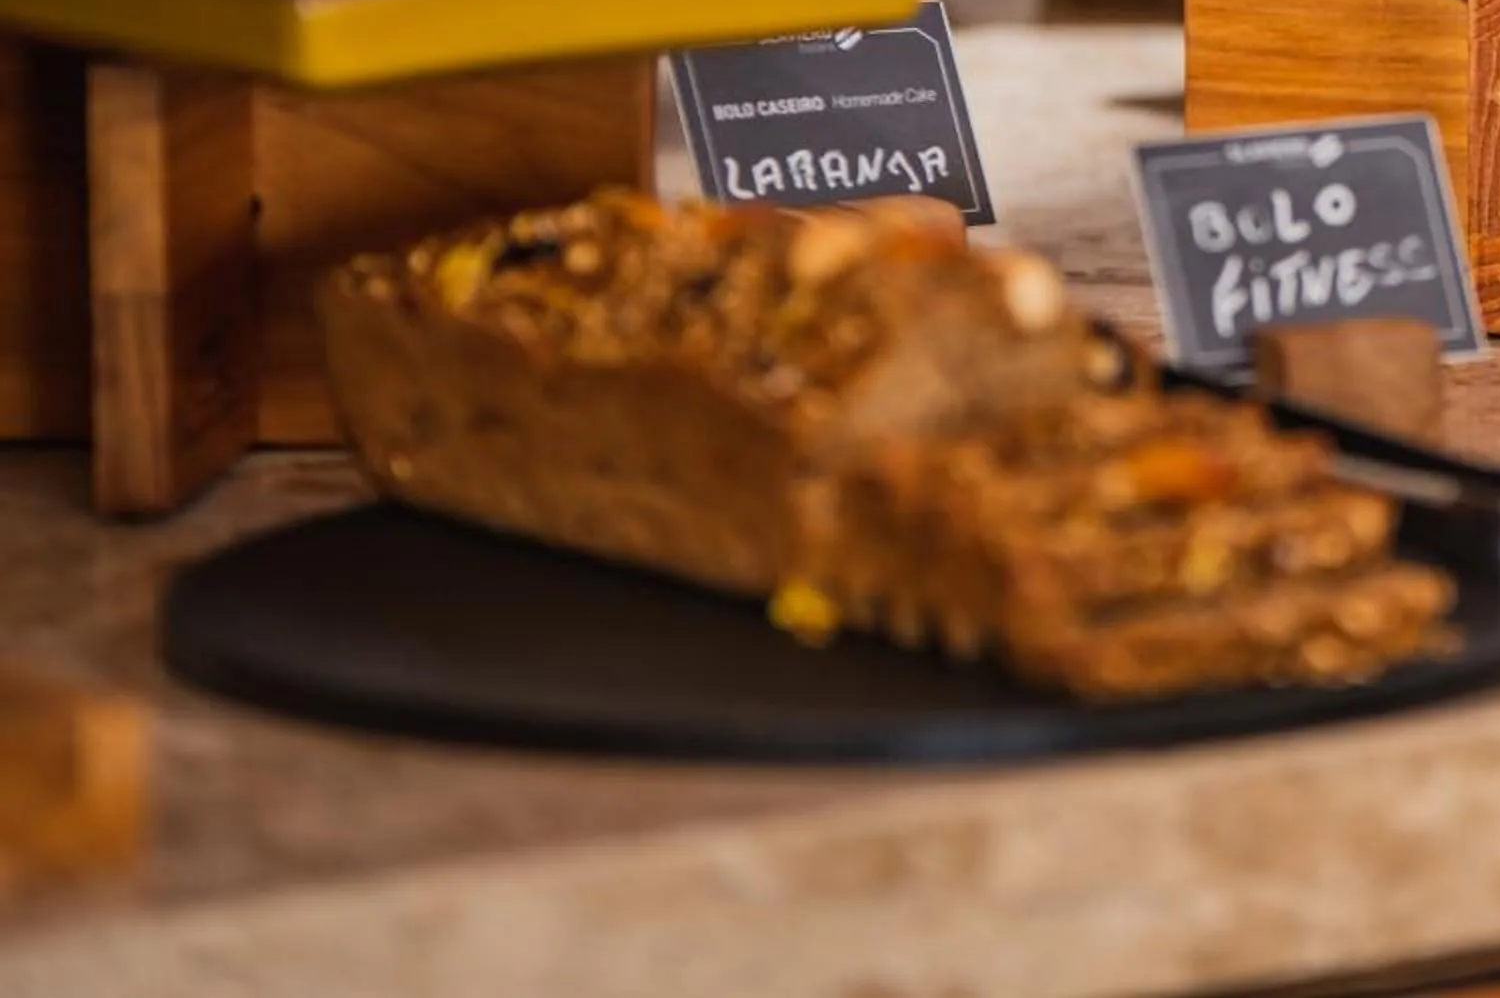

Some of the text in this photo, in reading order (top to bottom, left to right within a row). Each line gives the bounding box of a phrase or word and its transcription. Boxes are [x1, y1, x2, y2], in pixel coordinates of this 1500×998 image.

[712, 86, 938, 122] BOLO CASEIRO Homemade Cake
[723, 145, 949, 200] LARANJA
[1188, 183, 1358, 254] BOLO
